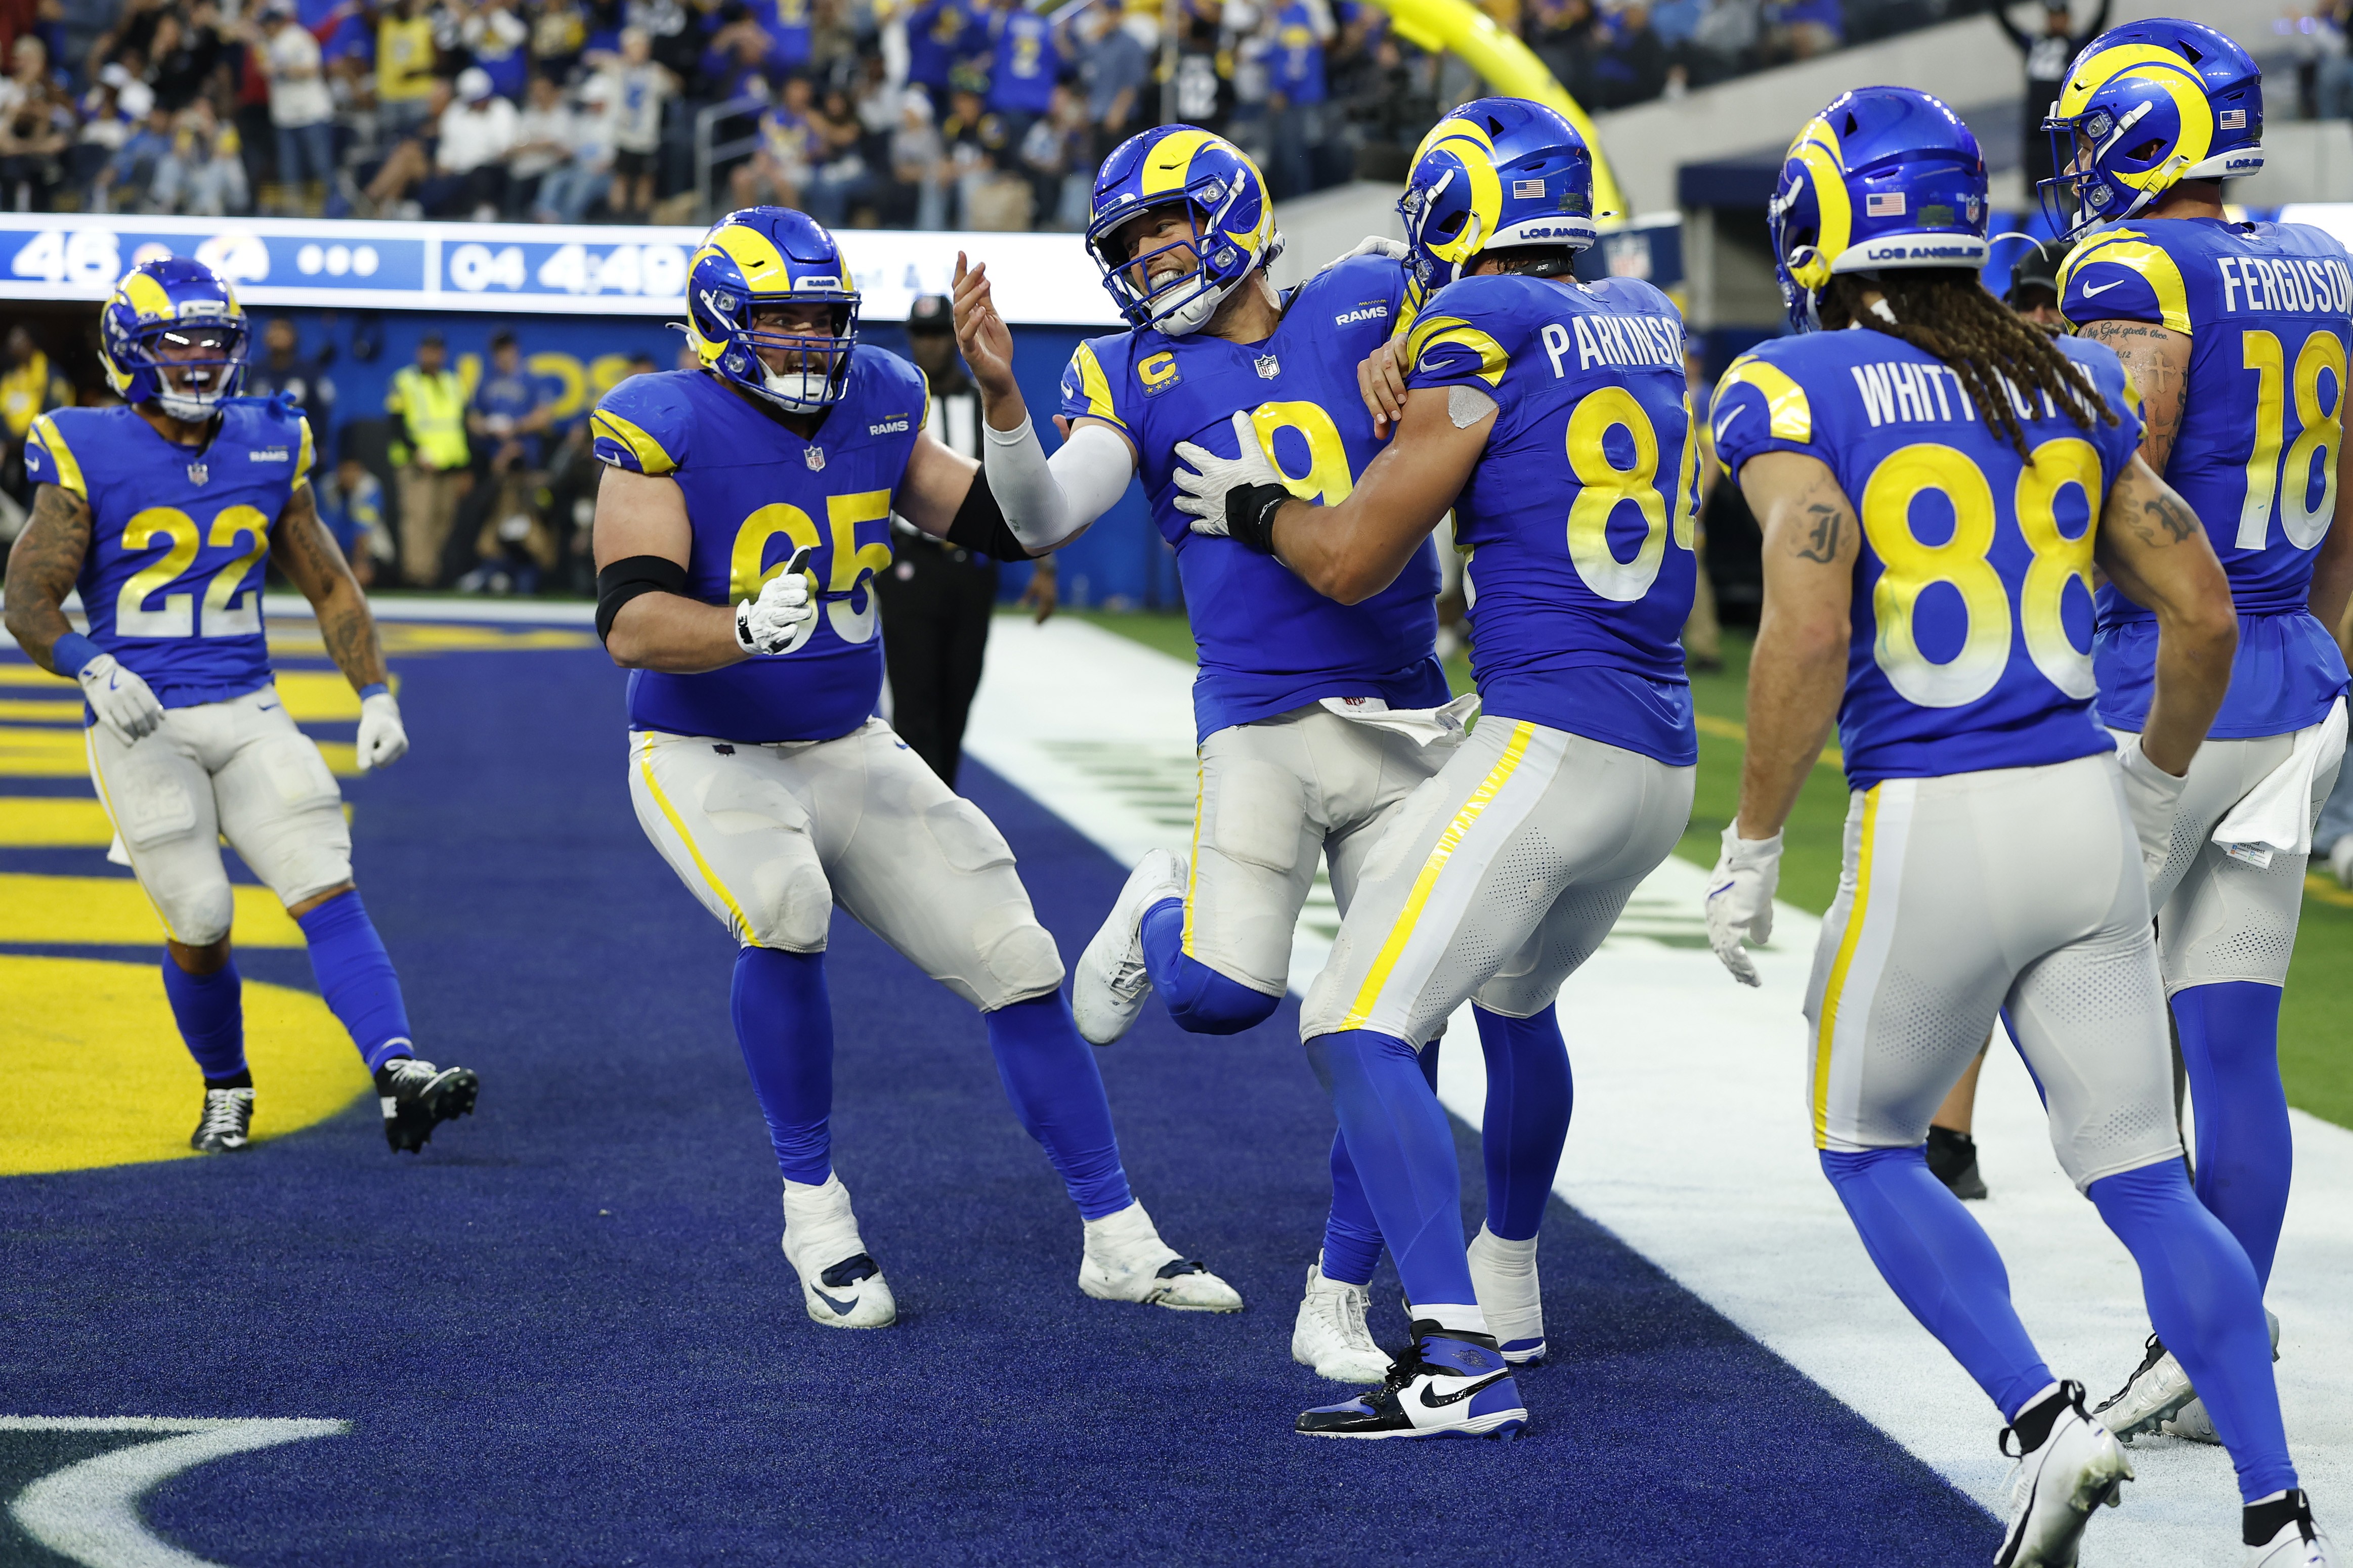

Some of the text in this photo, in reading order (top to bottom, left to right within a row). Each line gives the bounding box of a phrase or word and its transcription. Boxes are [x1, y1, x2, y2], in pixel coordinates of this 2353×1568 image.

[1097, 198, 1122, 216] RAMS
[1520, 228, 1551, 239] LOS
[11, 229, 121, 284] 46
[1868, 248, 1906, 260] LOS
[2216, 256, 2352, 316] FERGUSON
[1335, 306, 1388, 326] RAMS
[2100, 321, 2122, 340] God
[1541, 315, 1685, 379] PARKINSO
[1138, 351, 1176, 385] C
[1260, 364, 1277, 375] NFL
[869, 420, 909, 435] RAMS
[2235, 330, 2346, 550] 18
[249, 449, 289, 462] RAMS
[1250, 401, 1353, 507] 9
[115, 504, 270, 638] 22
[729, 488, 892, 656] 65
[1861, 437, 2102, 708] 88
[2237, 842, 2265, 855] northwest
